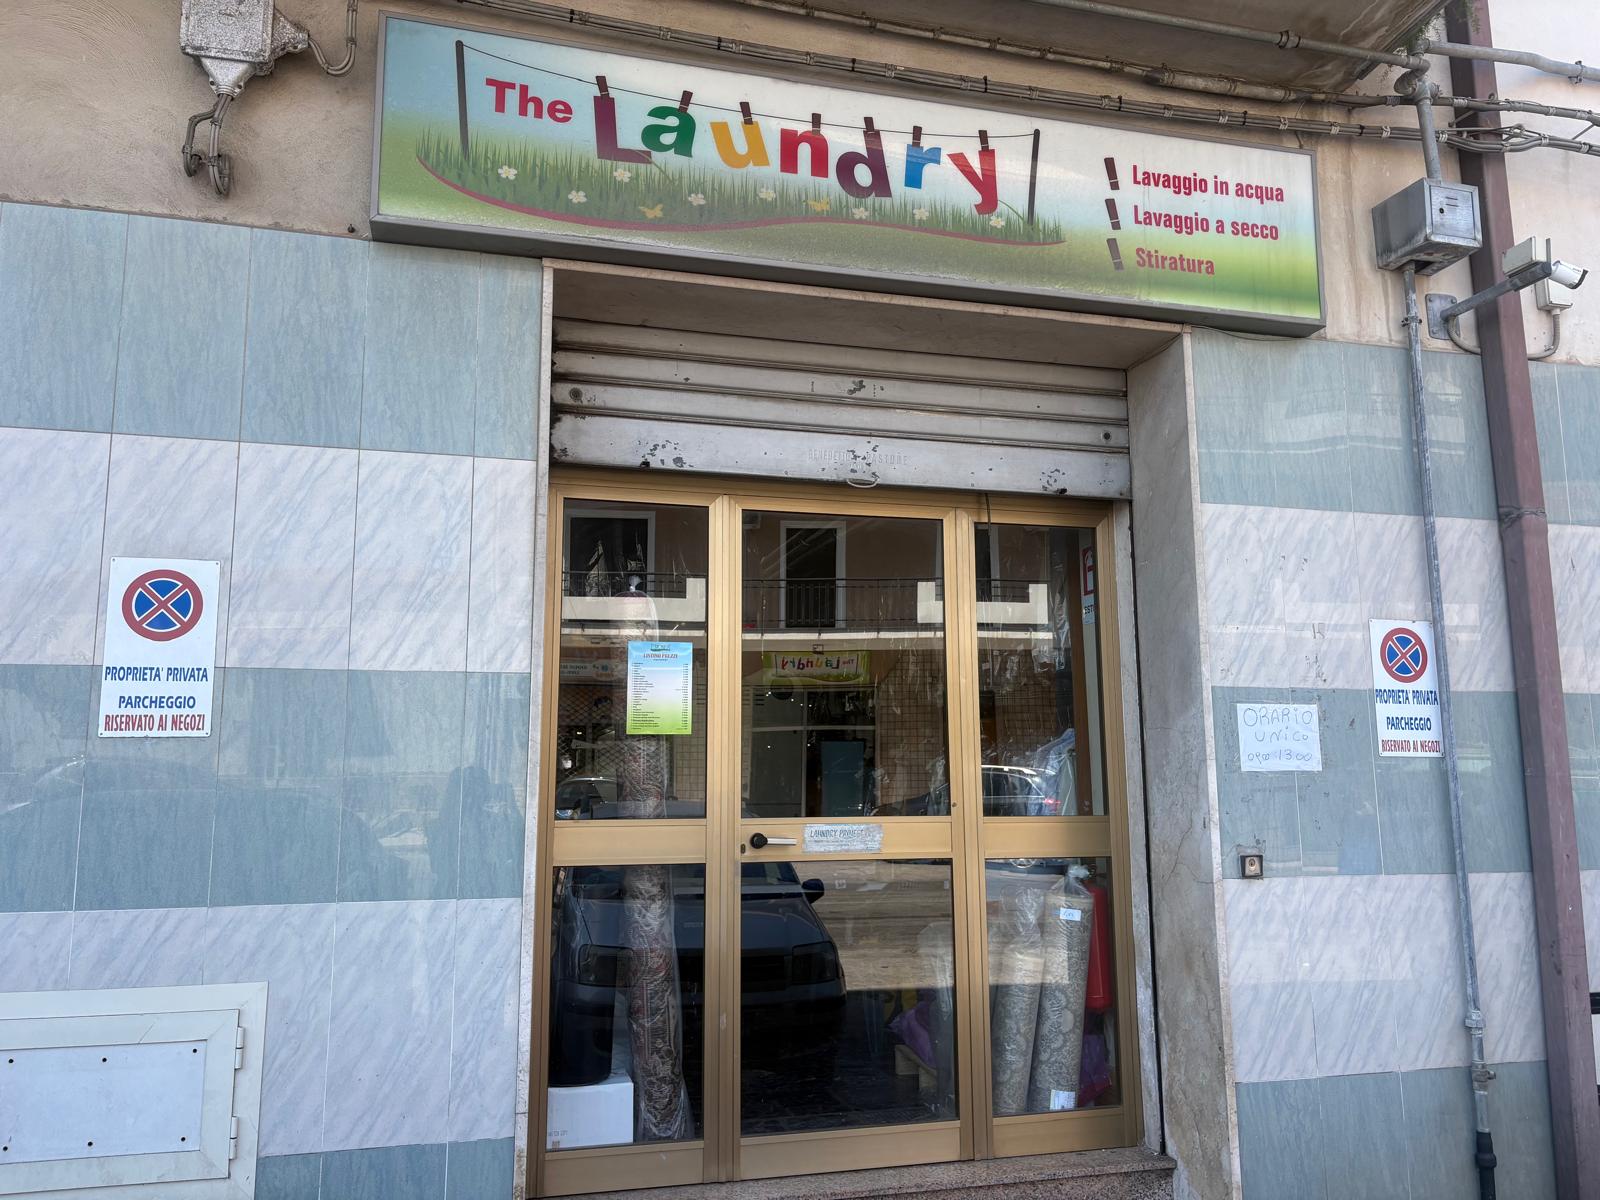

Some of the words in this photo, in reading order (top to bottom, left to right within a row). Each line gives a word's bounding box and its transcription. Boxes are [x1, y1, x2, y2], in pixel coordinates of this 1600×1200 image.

[486, 78, 572, 123] The
[593, 95, 998, 216] Laundry
[1132, 164, 1208, 196] Lavaggio
[1213, 175, 1229, 196] in
[1235, 182, 1284, 204] acqua
[1133, 205, 1209, 235] Lavaggio
[1215, 219, 1225, 234] a
[1231, 221, 1279, 240] secco
[1135, 247, 1215, 275] Stiratura
[104, 666, 163, 681] PROPRIETA'
[166, 667, 208, 682] PRIVATA
[118, 695, 196, 709] PARCHEGGIO
[1375, 688, 1410, 704] PROPRIETA'
[1412, 690, 1439, 705] PRIVATA
[104, 714, 154, 732] RISERVATO
[157, 714, 167, 731] AI
[171, 714, 205, 731] NEGOZI
[1386, 716, 1432, 731] PARCHEGGIO
[1381, 740, 1411, 752] RISERVATO
[1412, 740, 1419, 752] AI
[1420, 740, 1441, 753] NEGOZI
